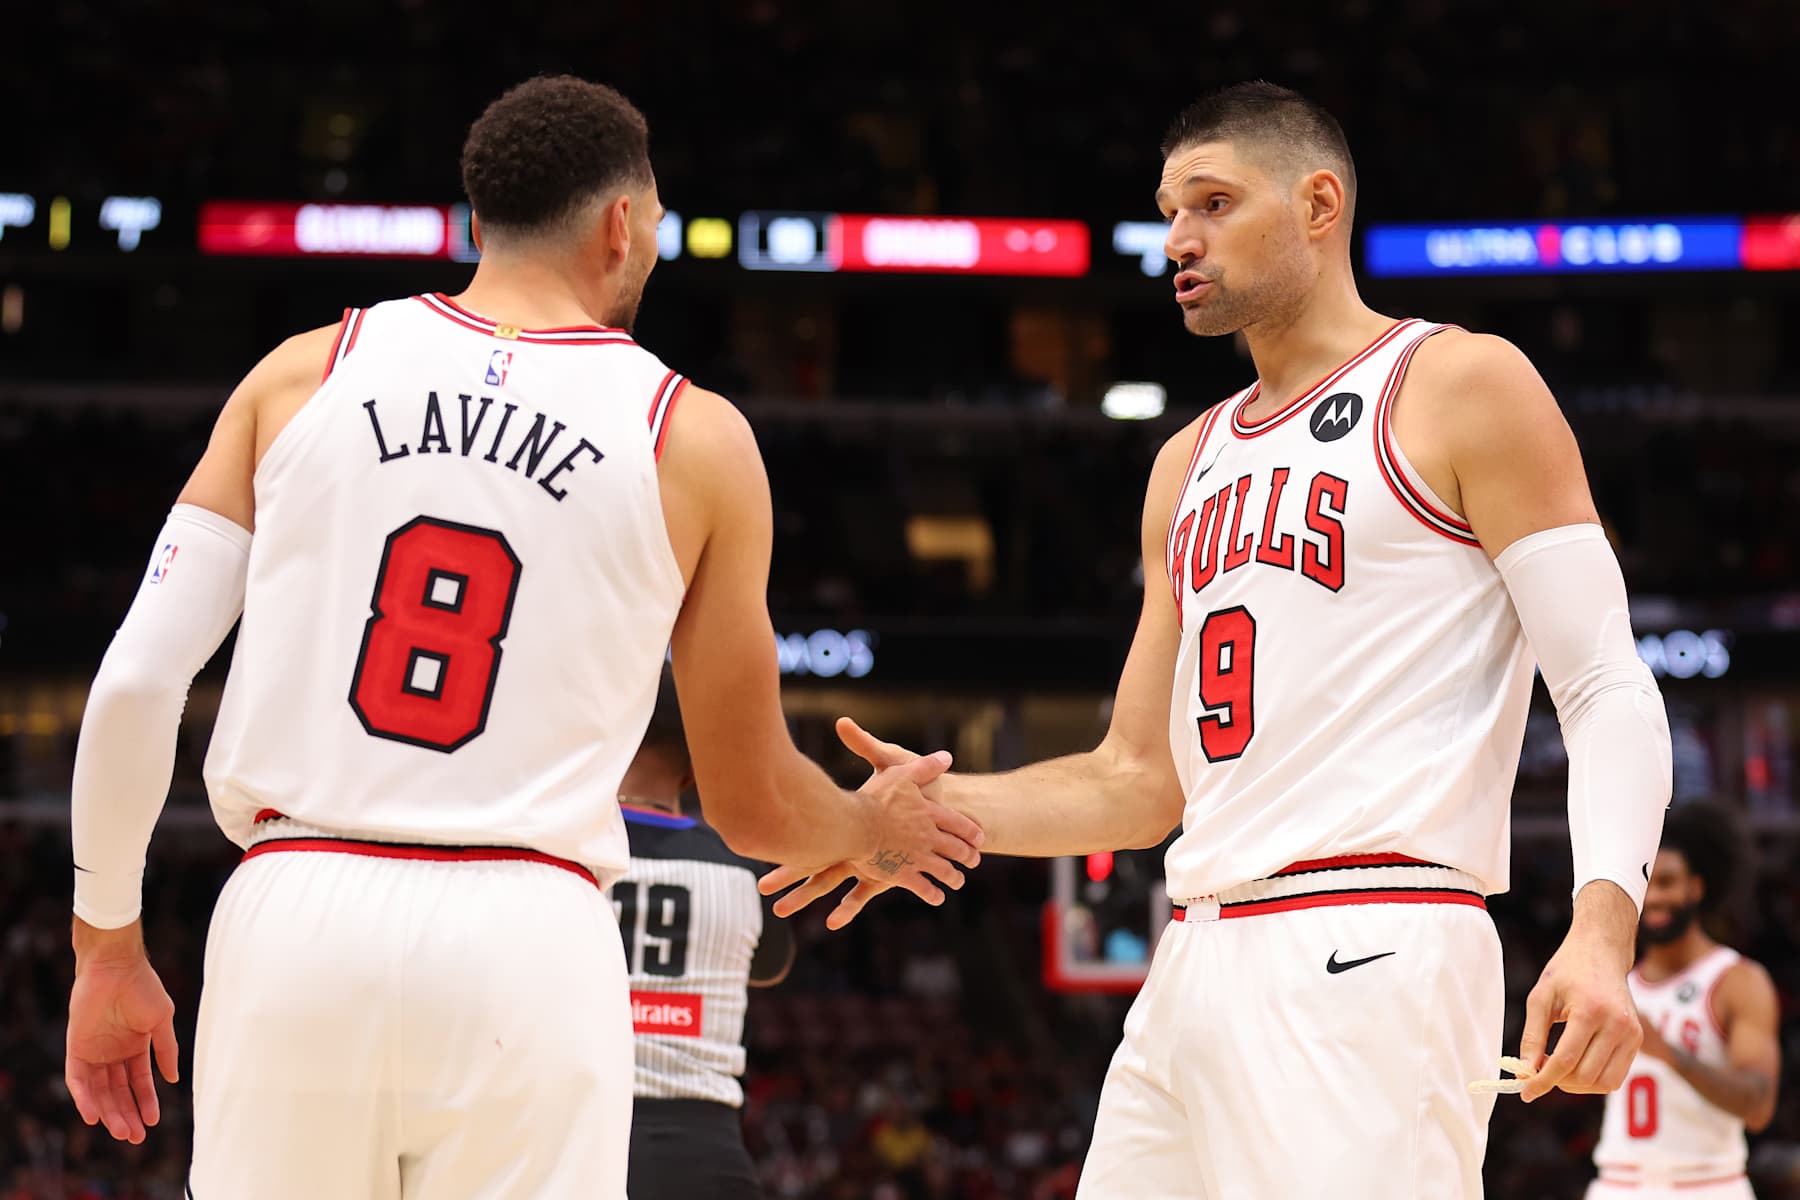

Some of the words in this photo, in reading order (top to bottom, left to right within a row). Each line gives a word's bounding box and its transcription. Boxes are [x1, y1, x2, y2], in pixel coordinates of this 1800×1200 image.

[363, 391, 605, 502] LAVINE
[348, 514, 523, 755] 8
[1197, 605, 1257, 764] 9
[611, 881, 691, 978] 19
[631, 998, 693, 1027] irates
[1627, 1073, 1658, 1140] 0
